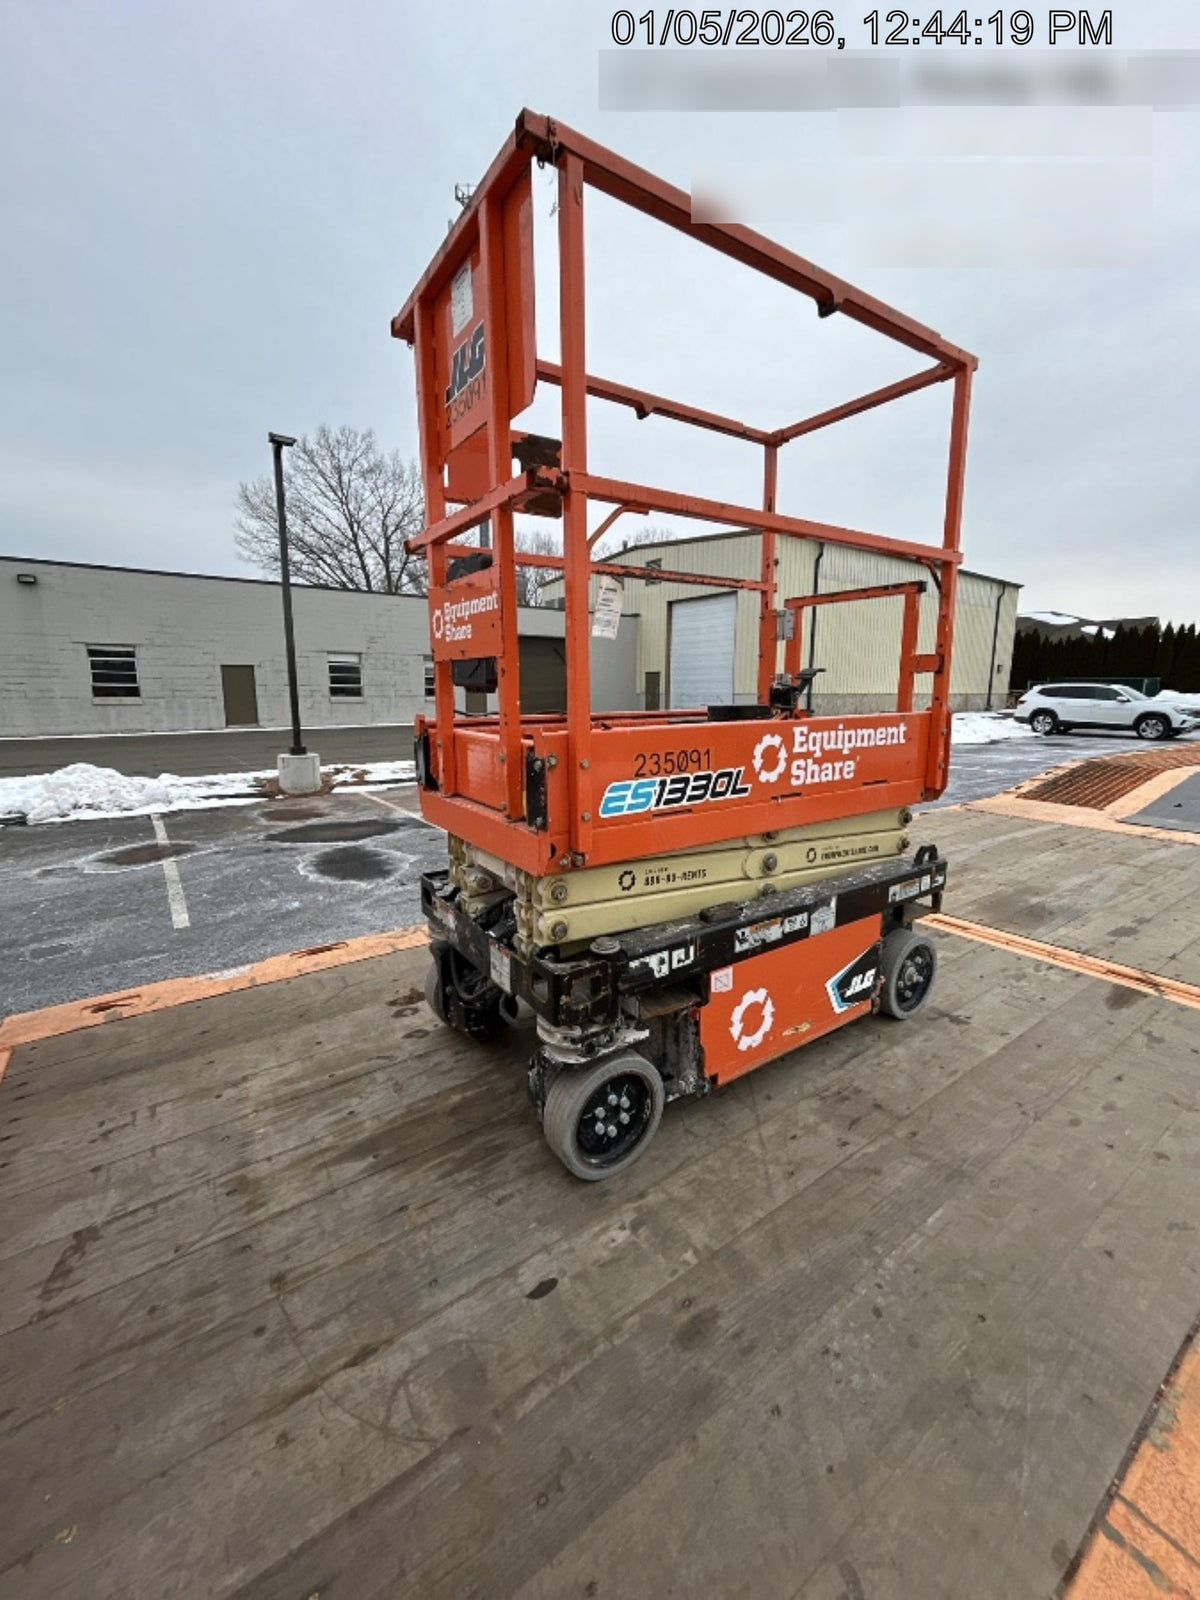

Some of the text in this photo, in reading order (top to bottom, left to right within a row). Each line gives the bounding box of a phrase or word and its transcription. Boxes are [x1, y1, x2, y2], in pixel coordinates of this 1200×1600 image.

[444, 319, 485, 407] JLG
[444, 590, 498, 622] Equipment
[445, 624, 472, 641] Share
[792, 723, 907, 757] Equipment
[634, 748, 711, 778] 235091
[790, 758, 856, 786] Share
[600, 767, 751, 816] ES1330L
[844, 967, 877, 998] JLG
